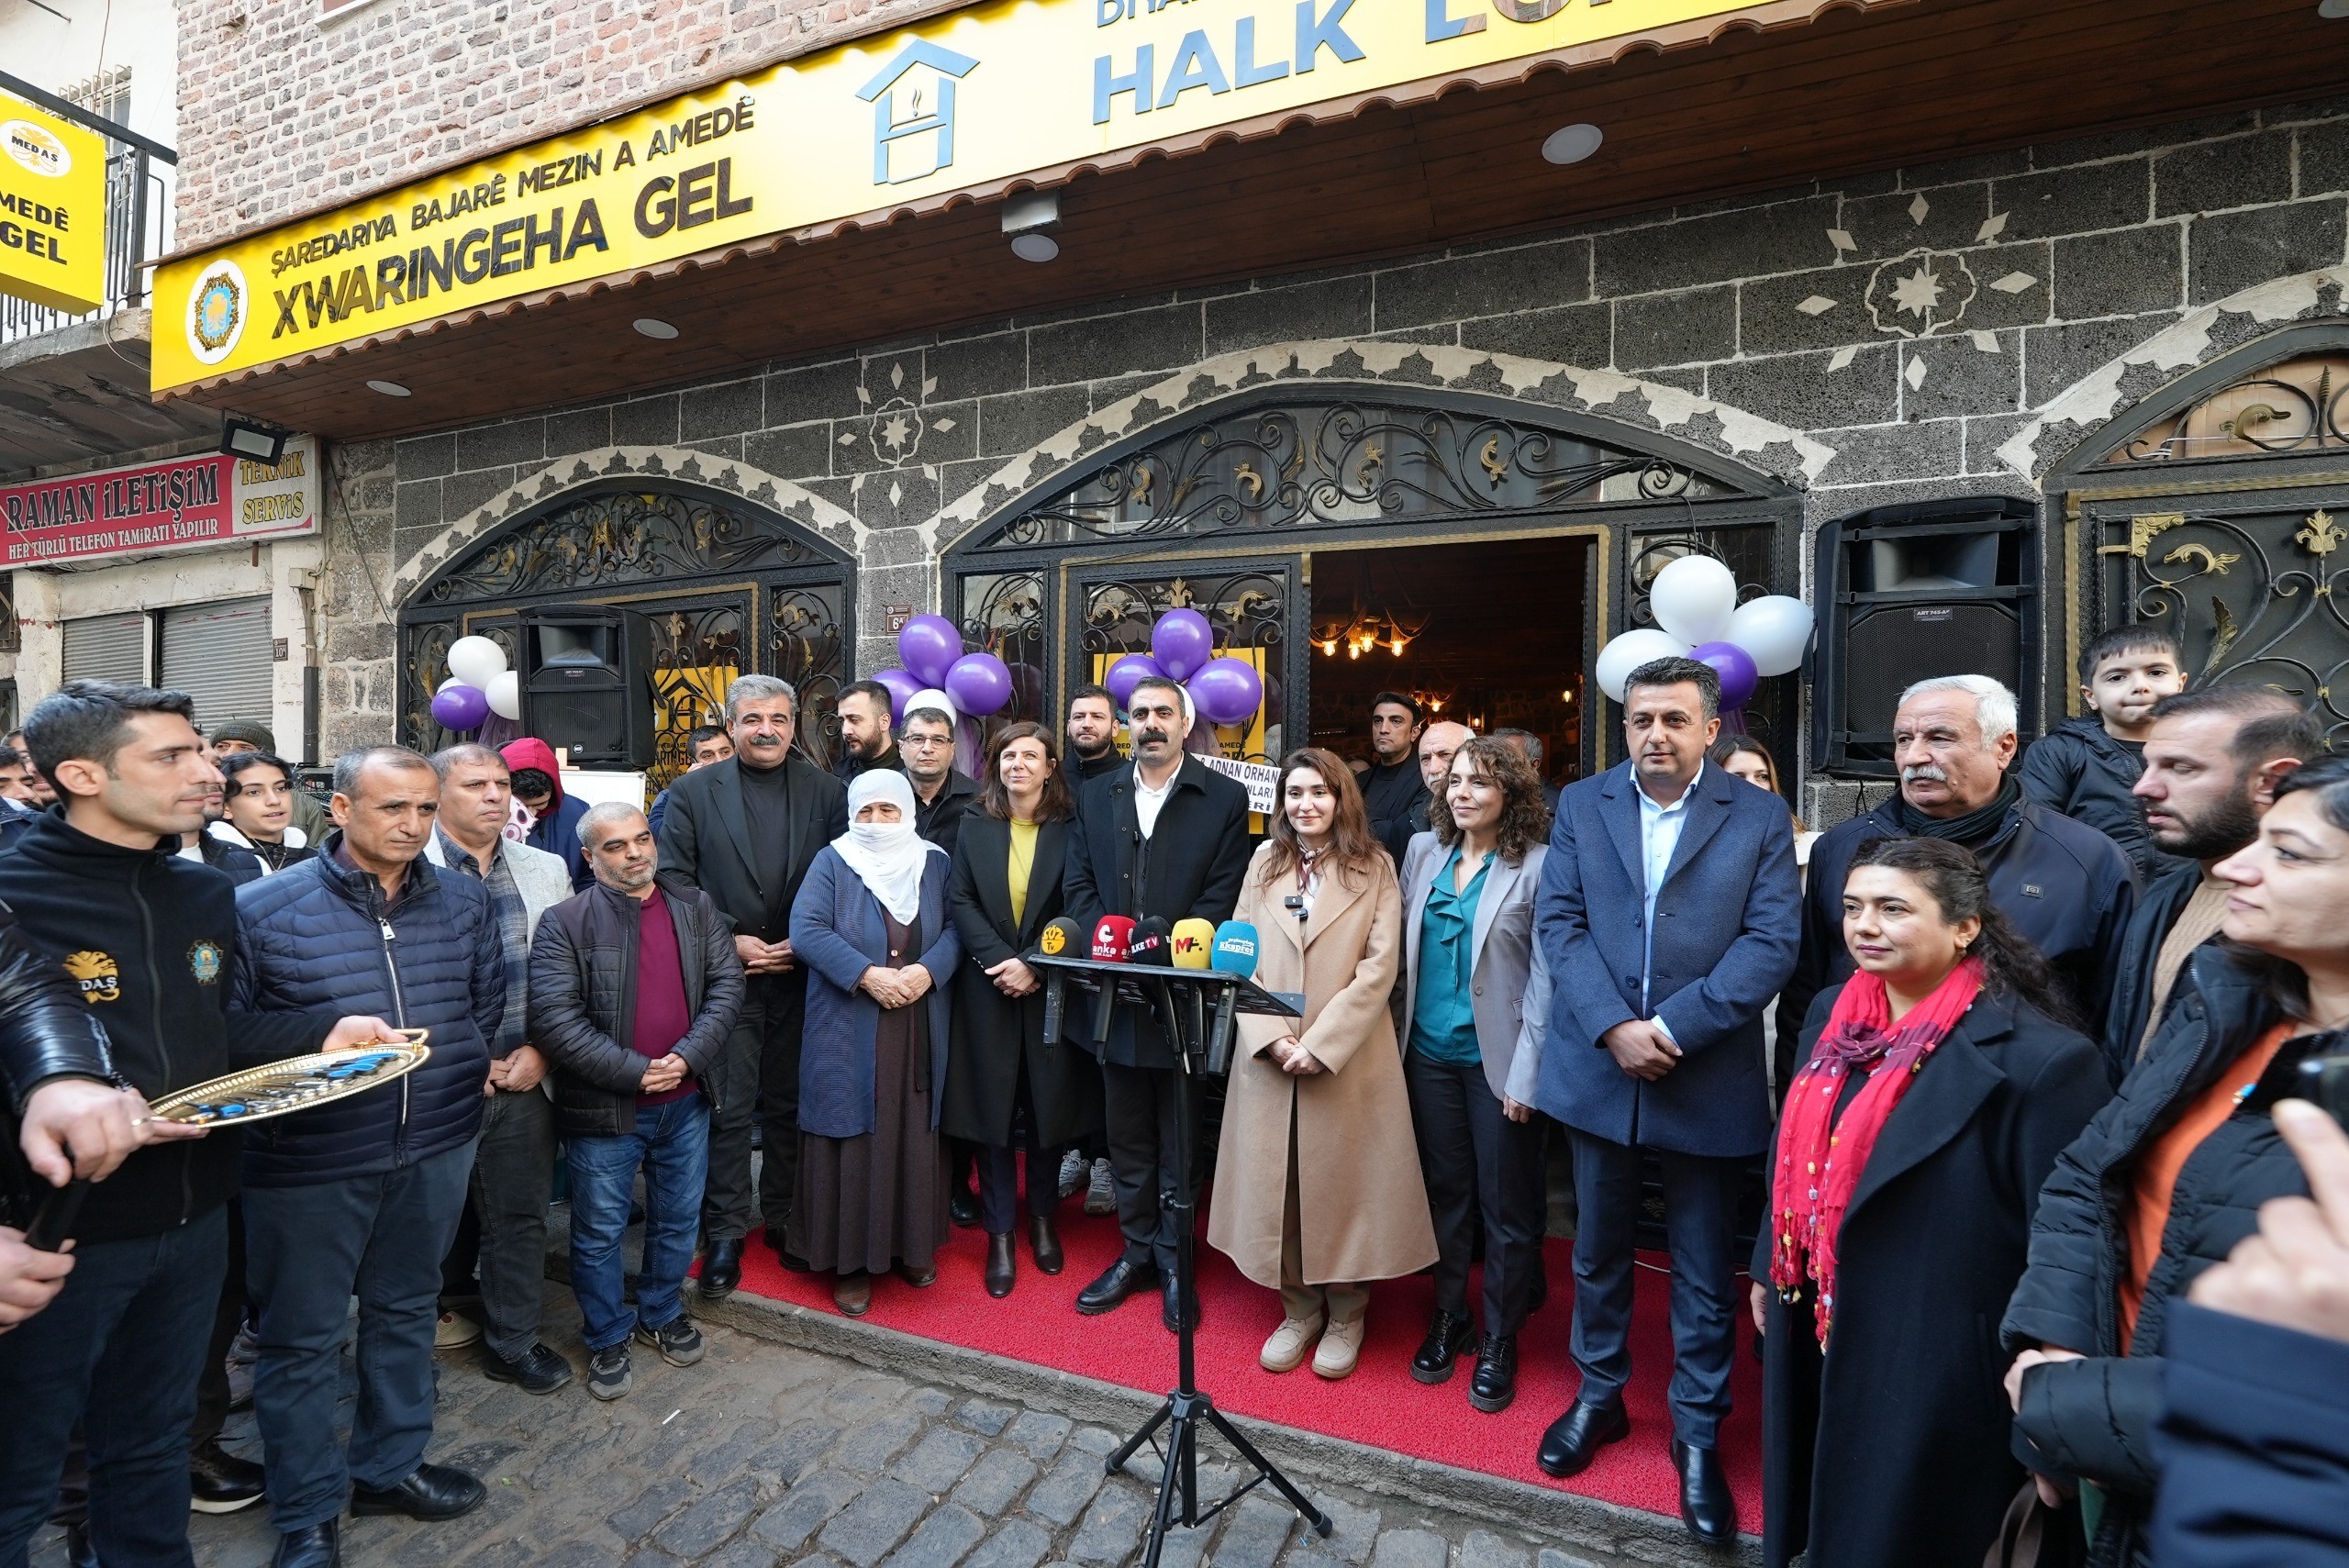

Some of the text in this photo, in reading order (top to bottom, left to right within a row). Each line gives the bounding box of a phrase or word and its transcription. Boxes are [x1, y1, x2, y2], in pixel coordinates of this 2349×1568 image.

[1093, 0, 1366, 125] HALK
[271, 93, 755, 278] ŞAREDARIYA BAJARÊ MEZIN A AMEDÊ
[0, 219, 68, 266] GEL
[272, 156, 753, 339] XWARINGEHA GEL
[6, 484, 95, 533] RAMAN
[8, 542, 30, 560] HER
[32, 534, 67, 558] TÜRLÜ
[69, 531, 116, 553] TELEFON
[173, 517, 219, 540] YAPILIR
[1209, 759, 1242, 778] ADNAN
[1247, 784, 1274, 798] NLARI
[1249, 801, 1270, 811] ERİ
[1092, 942, 1117, 955] anka
[1145, 937, 1158, 949] TV
[79, 976, 118, 990] DAŞ
